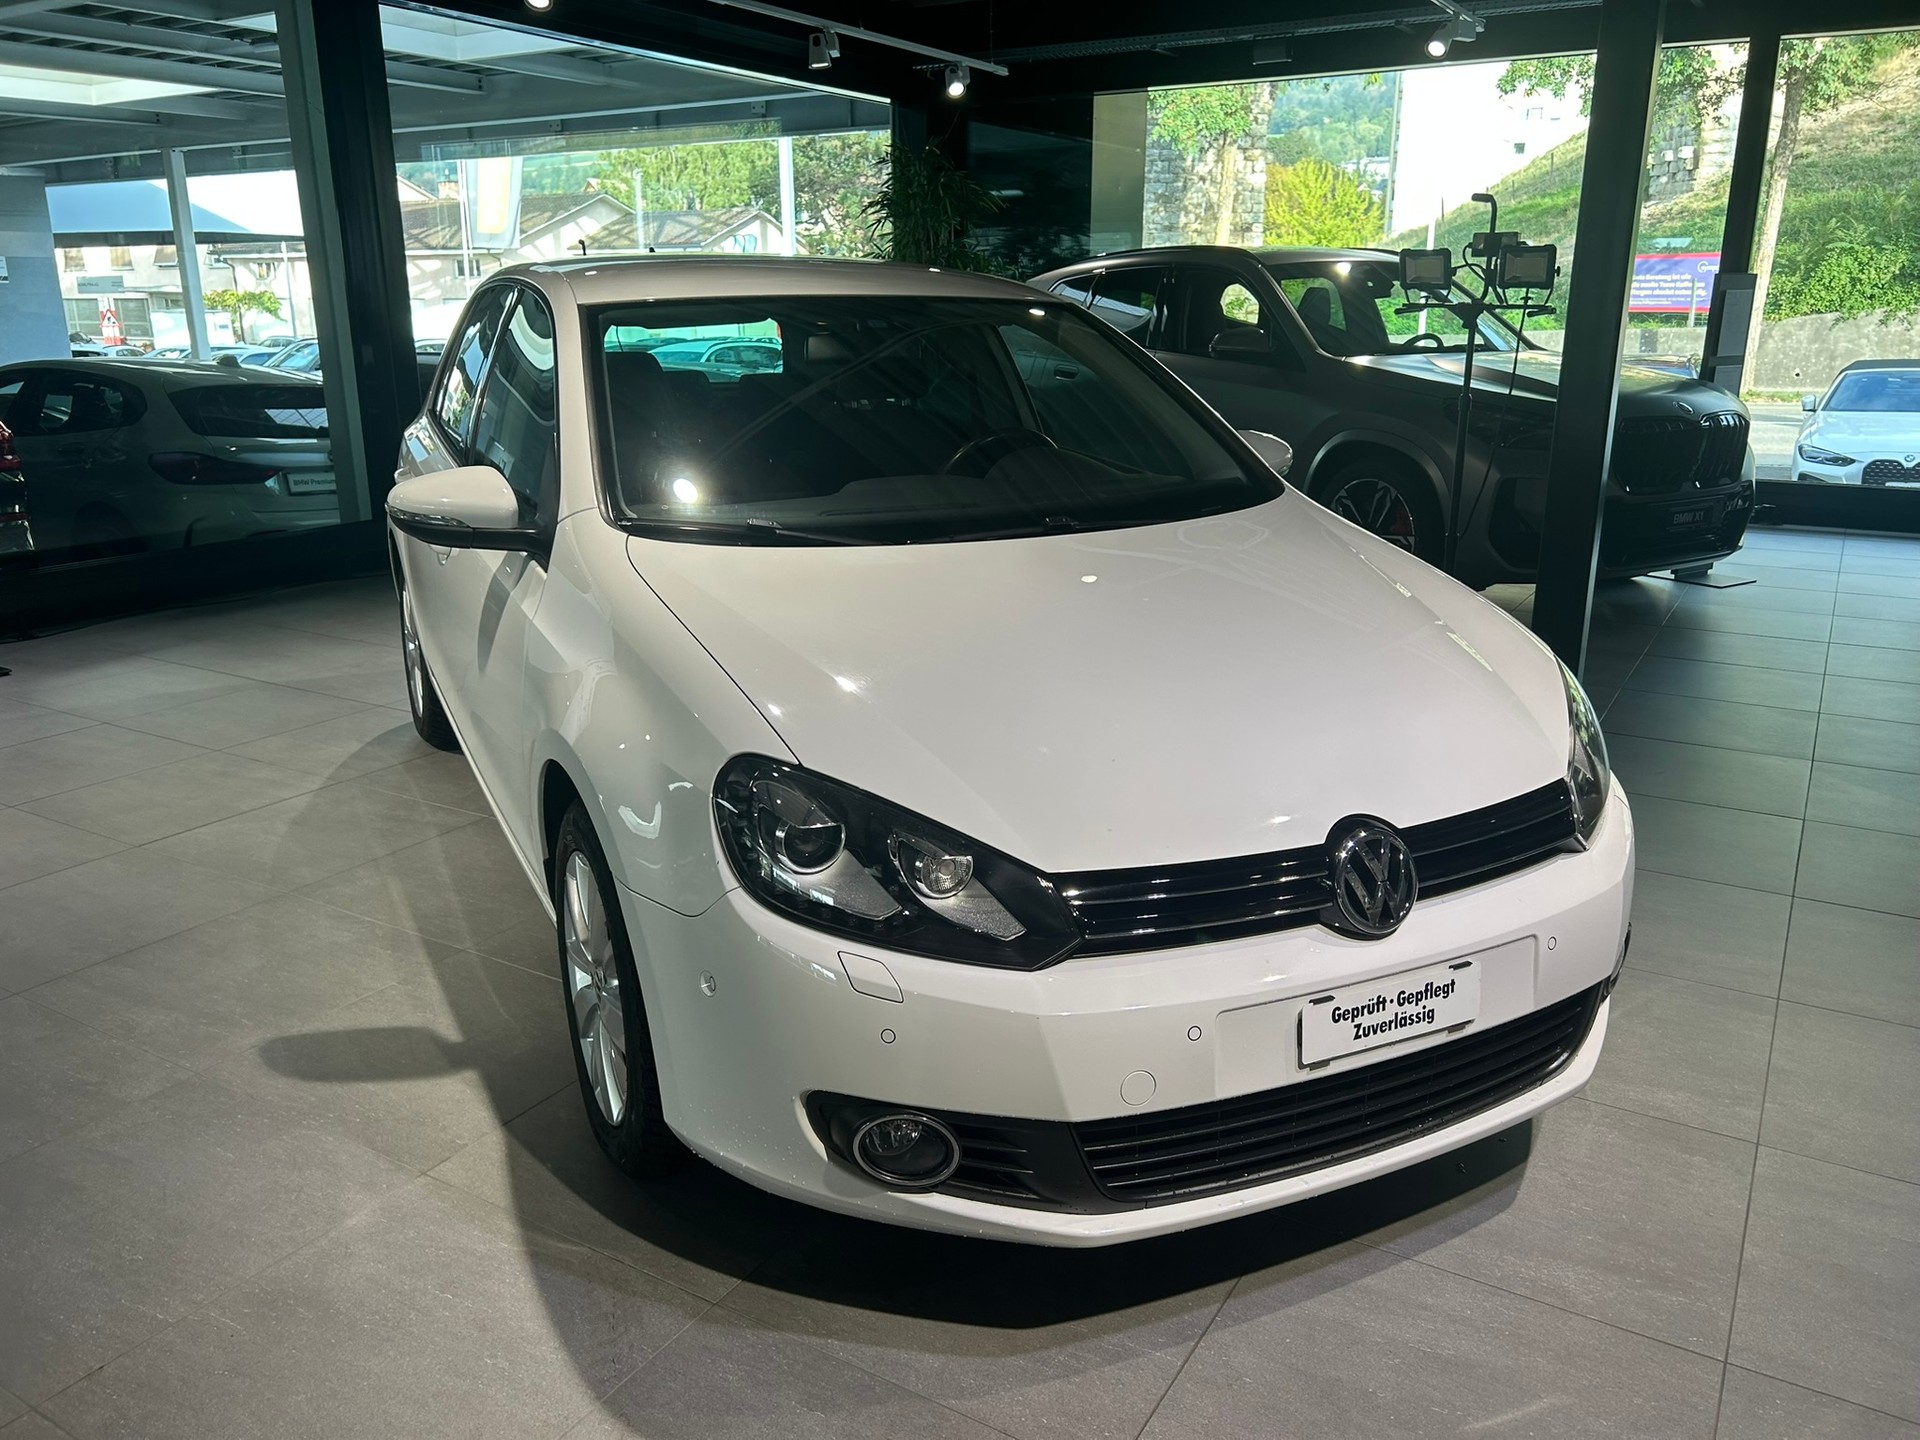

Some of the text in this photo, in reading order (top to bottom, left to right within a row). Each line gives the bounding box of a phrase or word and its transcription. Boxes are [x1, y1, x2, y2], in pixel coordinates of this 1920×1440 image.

[1673, 511, 1704, 524] BMW X1
[1331, 979, 1456, 1024] Geprüft Gepflegt
[1353, 1005, 1435, 1041] Zuverlässig
